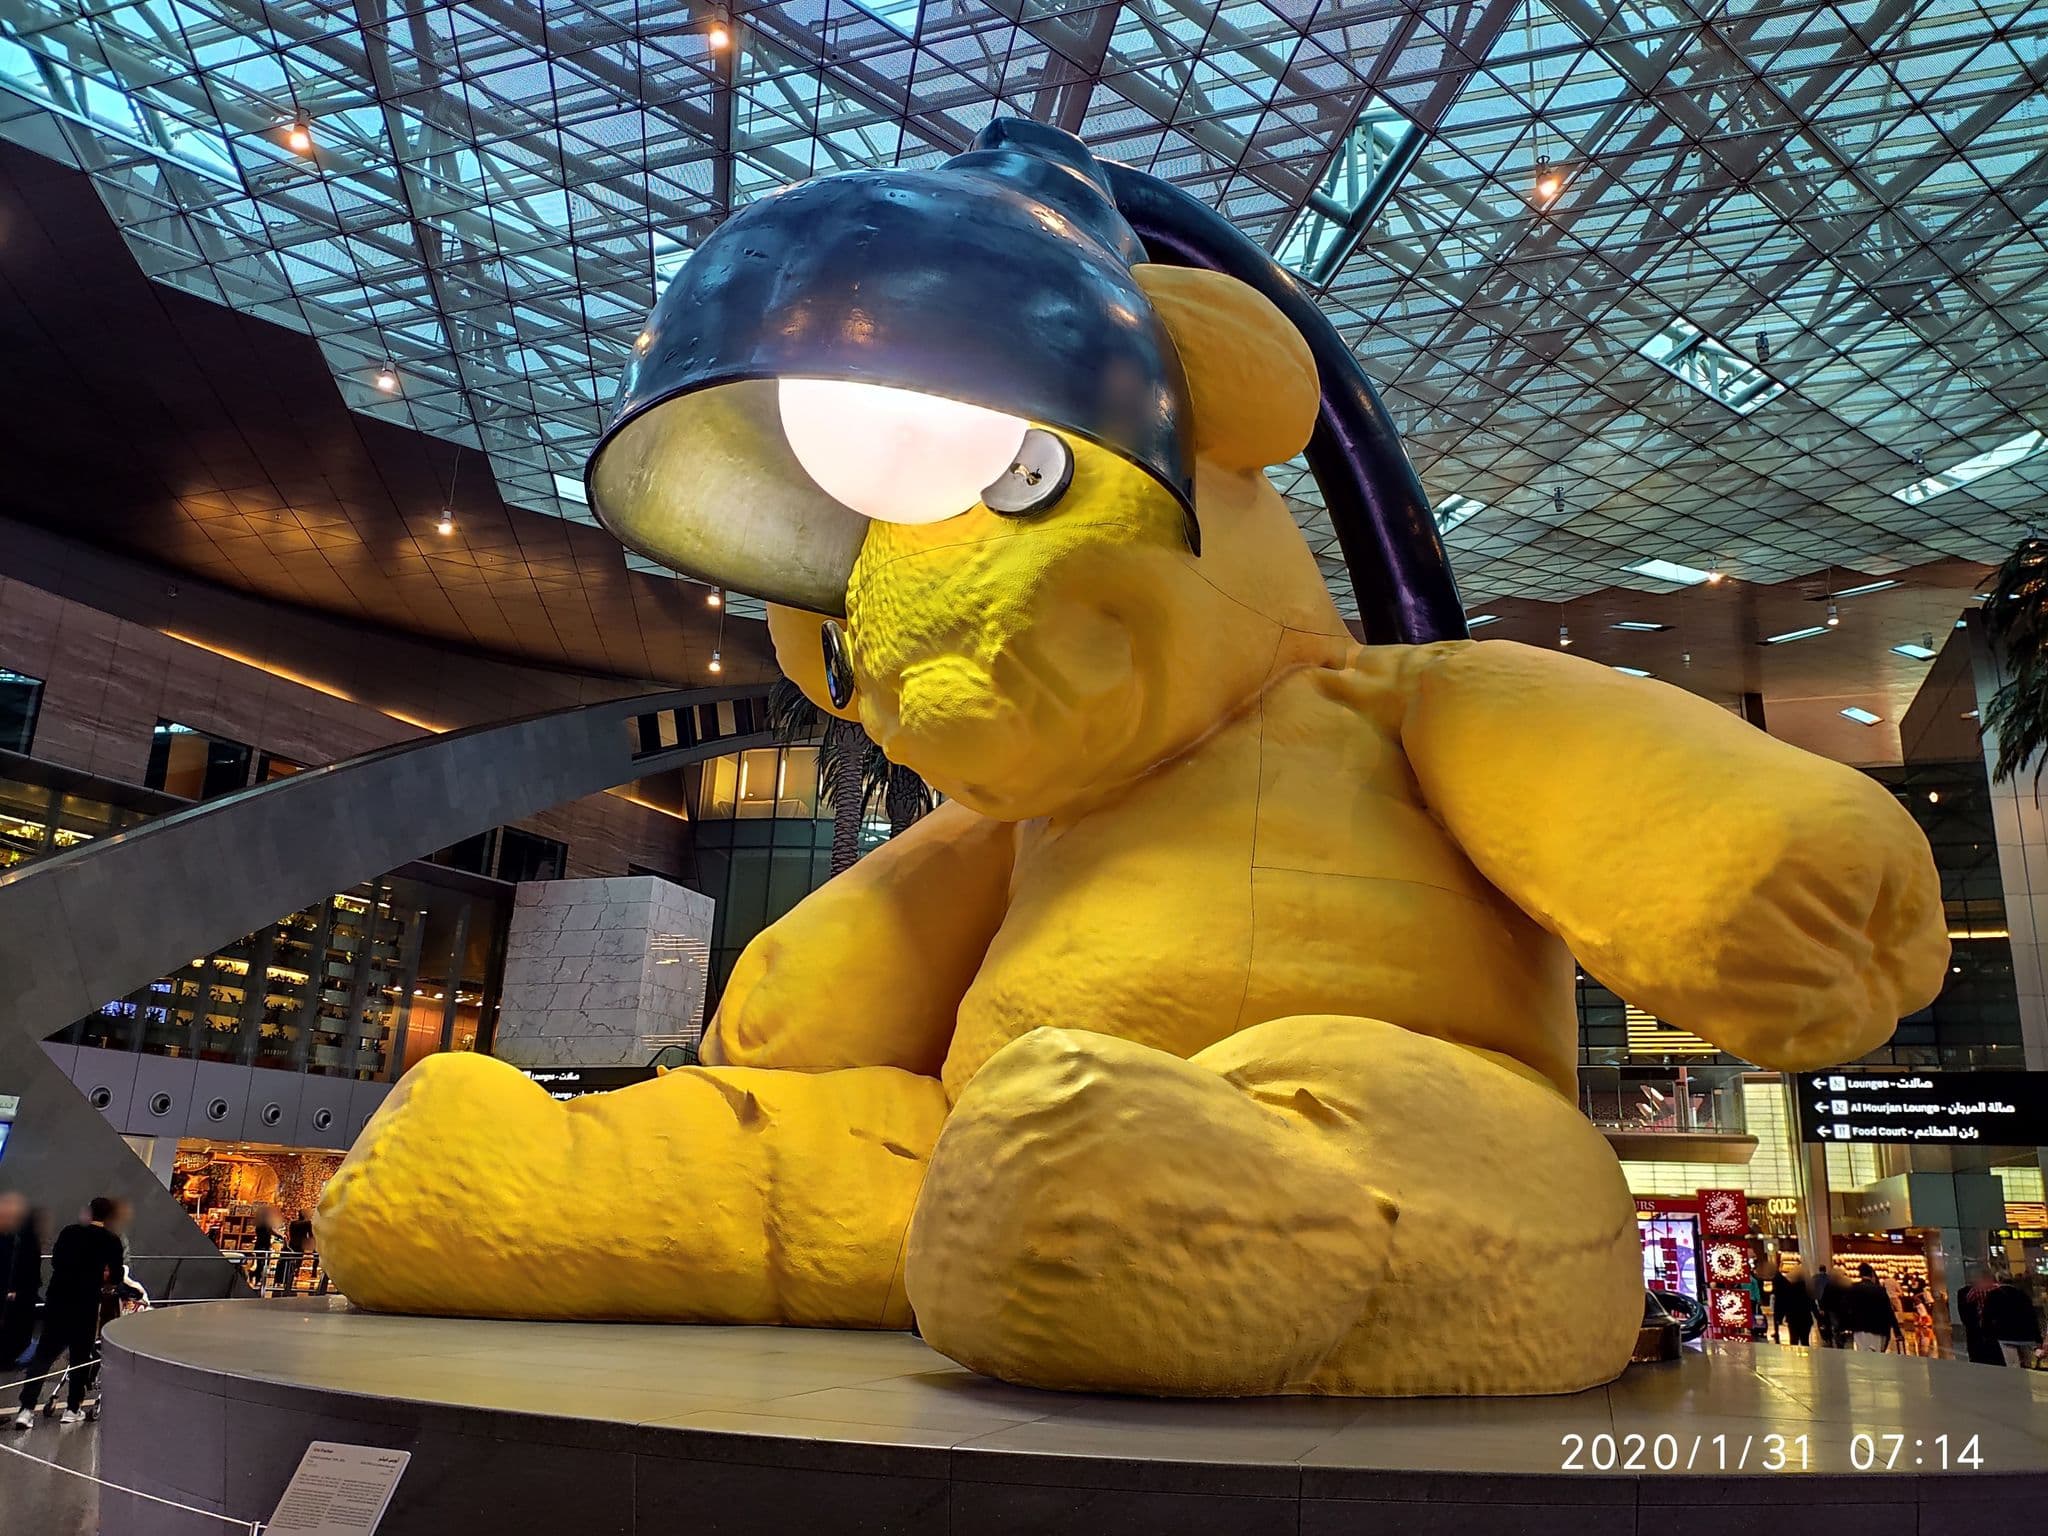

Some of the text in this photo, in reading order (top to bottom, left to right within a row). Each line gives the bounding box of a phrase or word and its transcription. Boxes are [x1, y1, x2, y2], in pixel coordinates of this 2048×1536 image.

[1847, 1079, 1890, 1091] Lounges
[1896, 1077, 1934, 1089] صالات
[1851, 1102, 1862, 1113] Al
[1862, 1102, 1902, 1115] Mourjan
[1903, 1103, 1940, 1115] Lounge
[1947, 1102, 1986, 1115] المرجان
[1987, 1101, 2016, 1113] صالة
[1852, 1126, 1877, 1137] Food
[1878, 1127, 1907, 1137] Court
[1914, 1126, 1957, 1140] المطاعم
